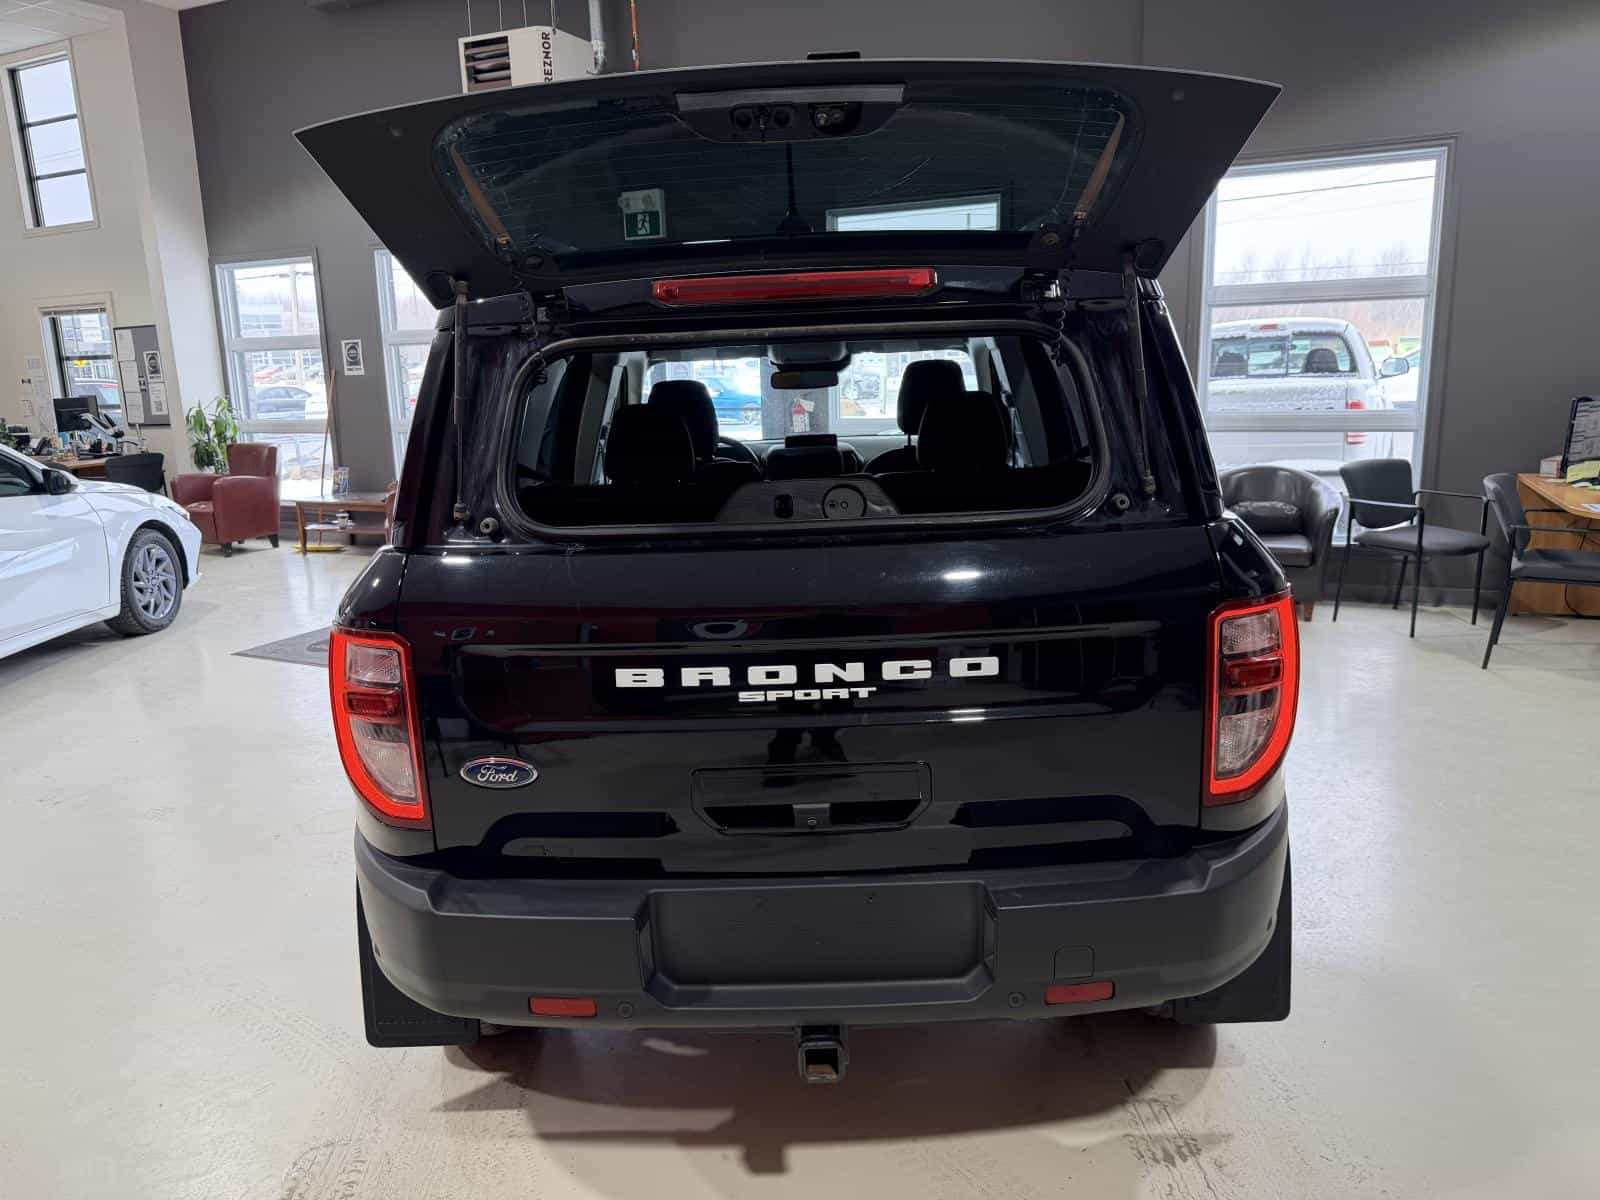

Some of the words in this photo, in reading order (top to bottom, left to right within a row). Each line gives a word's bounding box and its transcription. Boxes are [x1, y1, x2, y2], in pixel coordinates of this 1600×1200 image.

[615, 656, 1000, 688] BRONCO
[738, 687, 877, 702] SPORT
[477, 764, 519, 782] Ford
